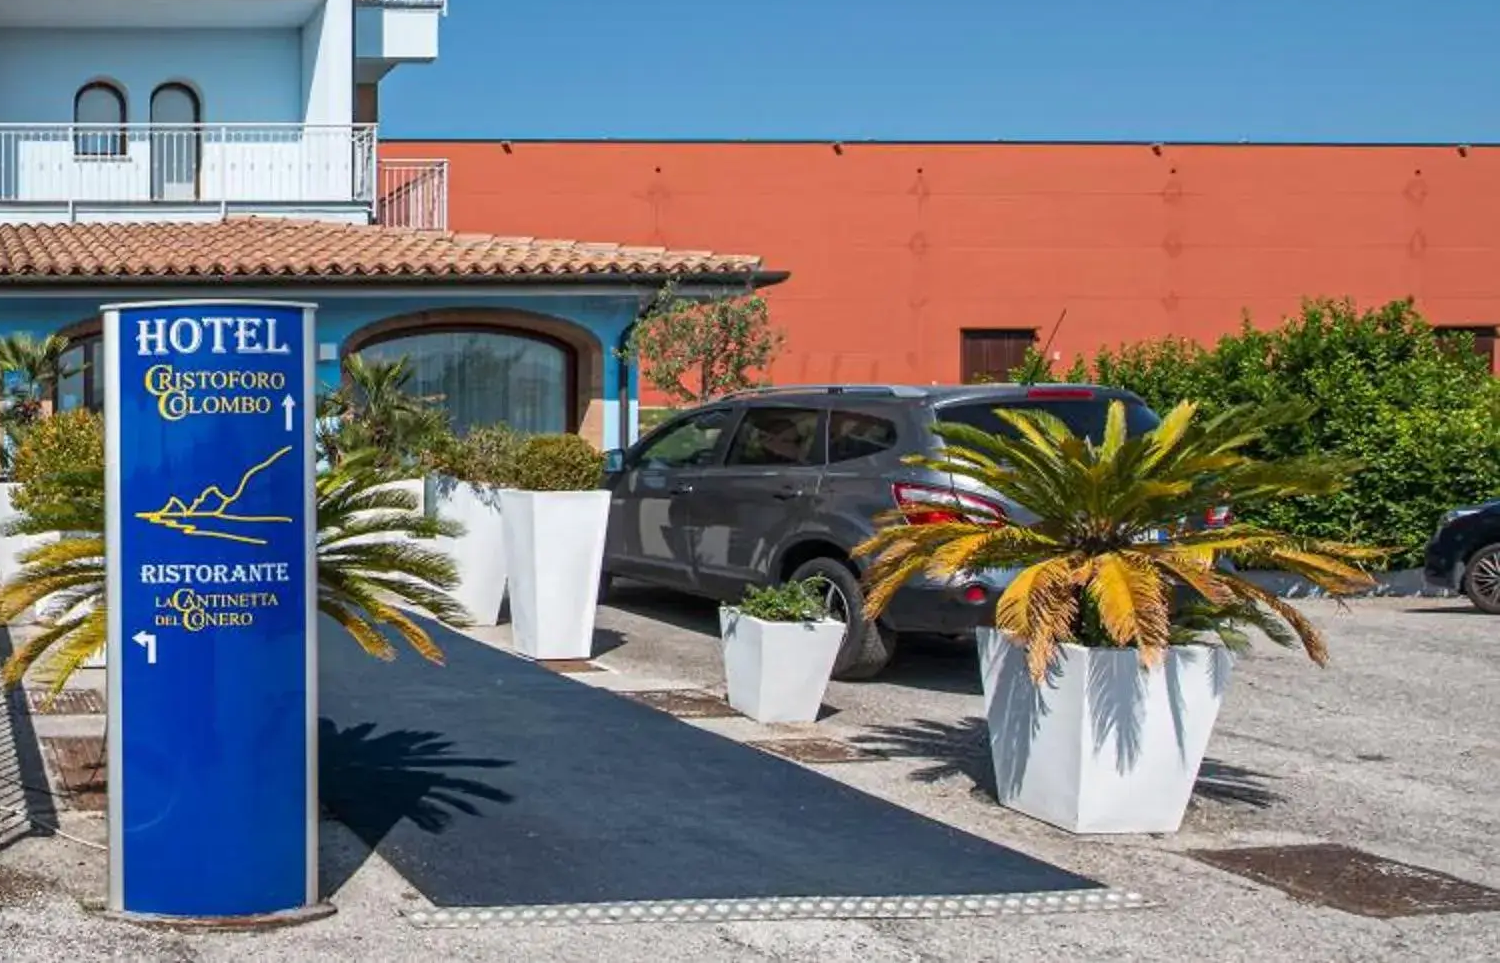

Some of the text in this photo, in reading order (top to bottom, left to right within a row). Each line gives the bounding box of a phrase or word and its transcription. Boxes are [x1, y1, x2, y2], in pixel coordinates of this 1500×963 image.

[136, 317, 291, 355] HOTEL
[144, 364, 286, 396] CRISTOFORO
[158, 388, 271, 421] COLOMBO
[140, 563, 290, 584] RISTORANTE
[155, 588, 279, 612] LA CANTINETTA
[155, 606, 253, 632] DEL CONERO
